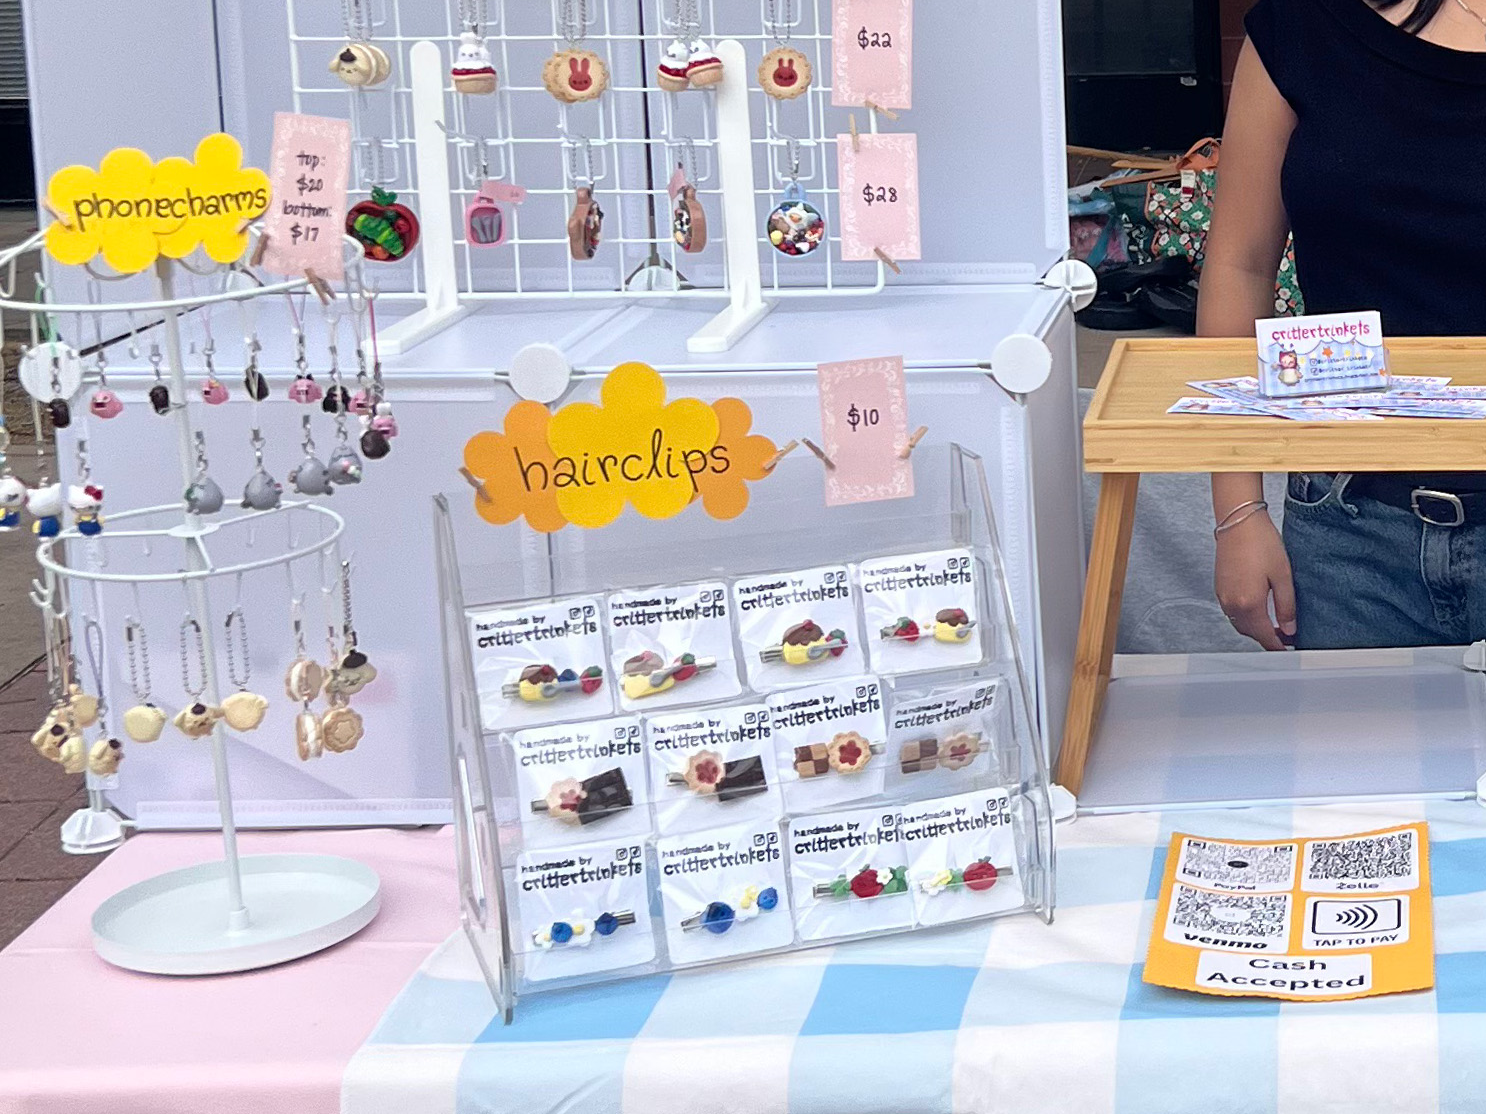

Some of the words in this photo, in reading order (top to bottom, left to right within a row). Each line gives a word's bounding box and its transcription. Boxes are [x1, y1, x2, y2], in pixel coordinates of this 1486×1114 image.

[857, 26, 892, 51] $22
[296, 173, 324, 196] $20
[862, 183, 898, 207] $28
[73, 187, 268, 233] phonecharms
[290, 221, 319, 245] $17
[1271, 319, 1371, 342] crittertrinkets
[847, 403, 880, 432] $10
[513, 428, 731, 492] hairclips
[863, 565, 912, 578] handmade
[915, 563, 926, 573] by
[864, 568, 972, 594] crittertrinkets
[739, 581, 787, 595] handmade
[791, 578, 803, 588] by
[741, 585, 849, 611] crittertrinkets
[612, 597, 661, 610] handmade
[665, 596, 677, 606] by
[476, 616, 528, 631] handmade
[532, 615, 545, 625] by
[613, 603, 726, 627] crittertrinkets
[478, 620, 598, 648] crittertrinkets
[770, 697, 820, 713] handmade
[822, 695, 835, 705] by
[773, 697, 881, 730] crittertrinkets
[894, 695, 993, 729] crittertrinkets
[896, 702, 943, 715] handmade
[945, 698, 957, 708] by
[653, 721, 704, 734] handmade
[708, 719, 721, 728] by
[655, 723, 772, 751] crittertrinkets
[520, 736, 572, 749] handmade
[577, 734, 590, 743] by
[521, 738, 641, 767] crittertrinkets
[903, 809, 951, 824] handmade
[954, 807, 967, 817] by
[905, 812, 1011, 842] crittertrinkets
[794, 823, 843, 837] handmade
[847, 821, 860, 831] by
[662, 844, 715, 858] handmade
[718, 841, 731, 851] by
[664, 845, 780, 876] crittertrinkets
[521, 859, 575, 874] handmade
[579, 856, 592, 866] by
[522, 860, 642, 891] crittertrinkets
[1213, 882, 1256, 891] PayPal
[1184, 932, 1268, 950] venmo
[1313, 939, 1342, 947] TAP
[1346, 937, 1366, 946] TO
[1370, 933, 1399, 944] PAY
[1248, 958, 1327, 971] Cash
[1206, 972, 1365, 991] Accepted
